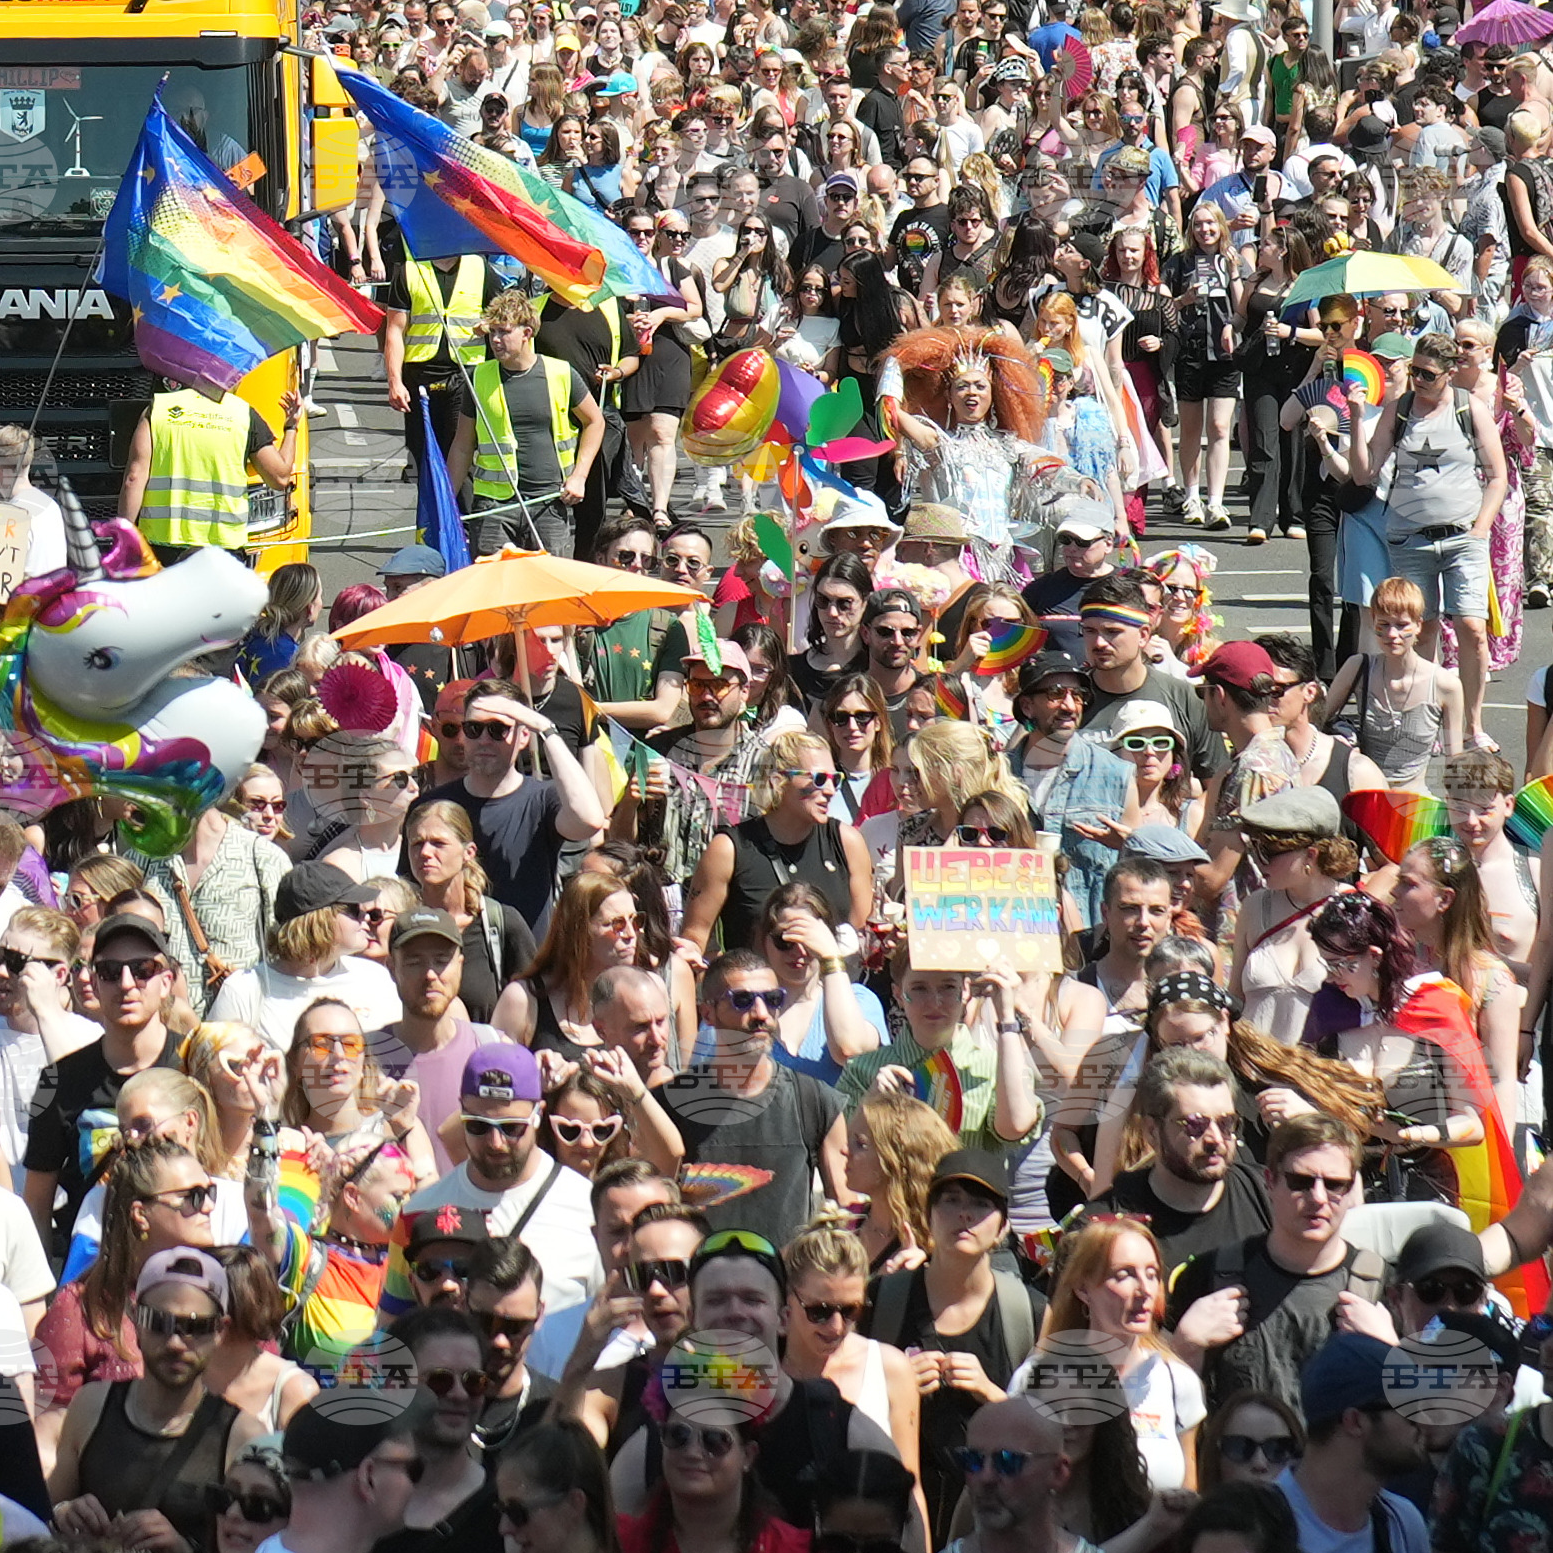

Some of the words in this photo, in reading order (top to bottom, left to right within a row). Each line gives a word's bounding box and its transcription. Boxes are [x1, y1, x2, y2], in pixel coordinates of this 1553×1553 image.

[910, 850, 1012, 893] LIEBE
[911, 894, 985, 931] WER
[987, 897, 1060, 934] KANN
